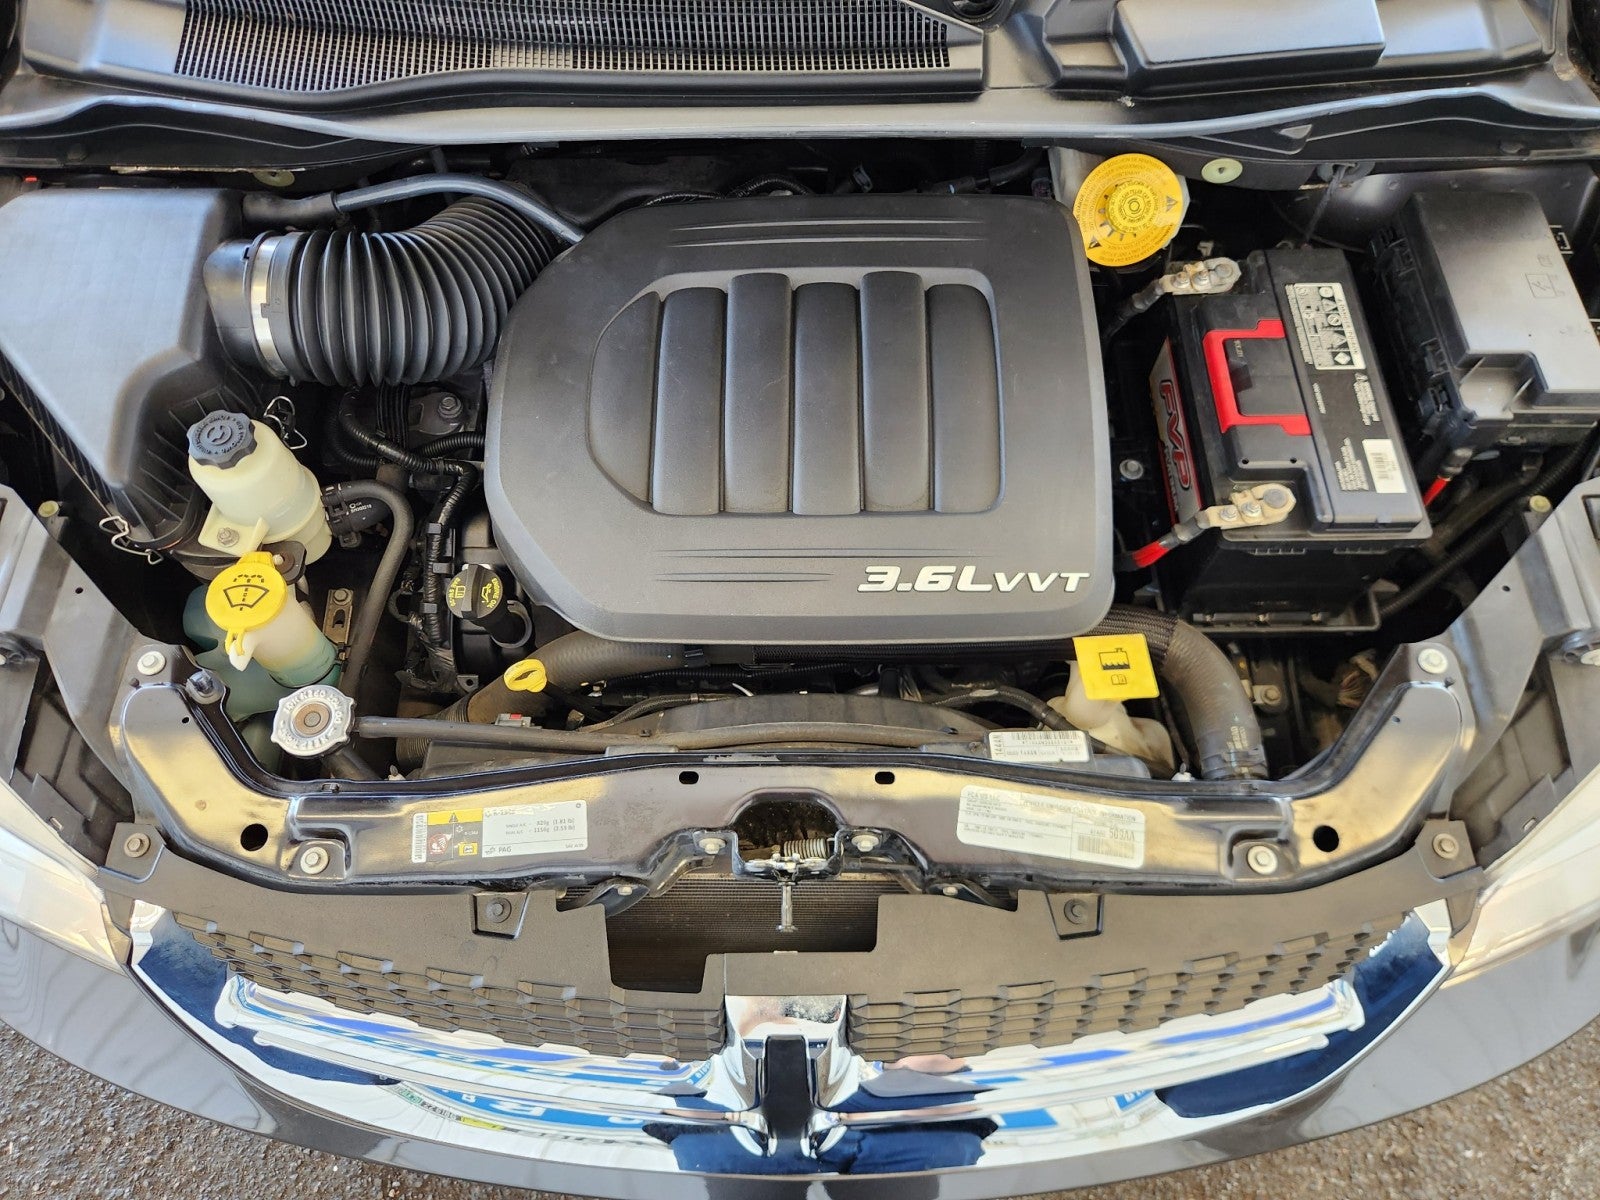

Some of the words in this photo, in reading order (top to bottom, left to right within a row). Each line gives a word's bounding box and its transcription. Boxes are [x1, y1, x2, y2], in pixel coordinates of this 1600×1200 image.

[1161, 379, 1190, 490] FVP
[491, 578, 500, 599] ENGINE
[487, 600, 497, 608] OIL
[498, 845, 512, 853] PAG
